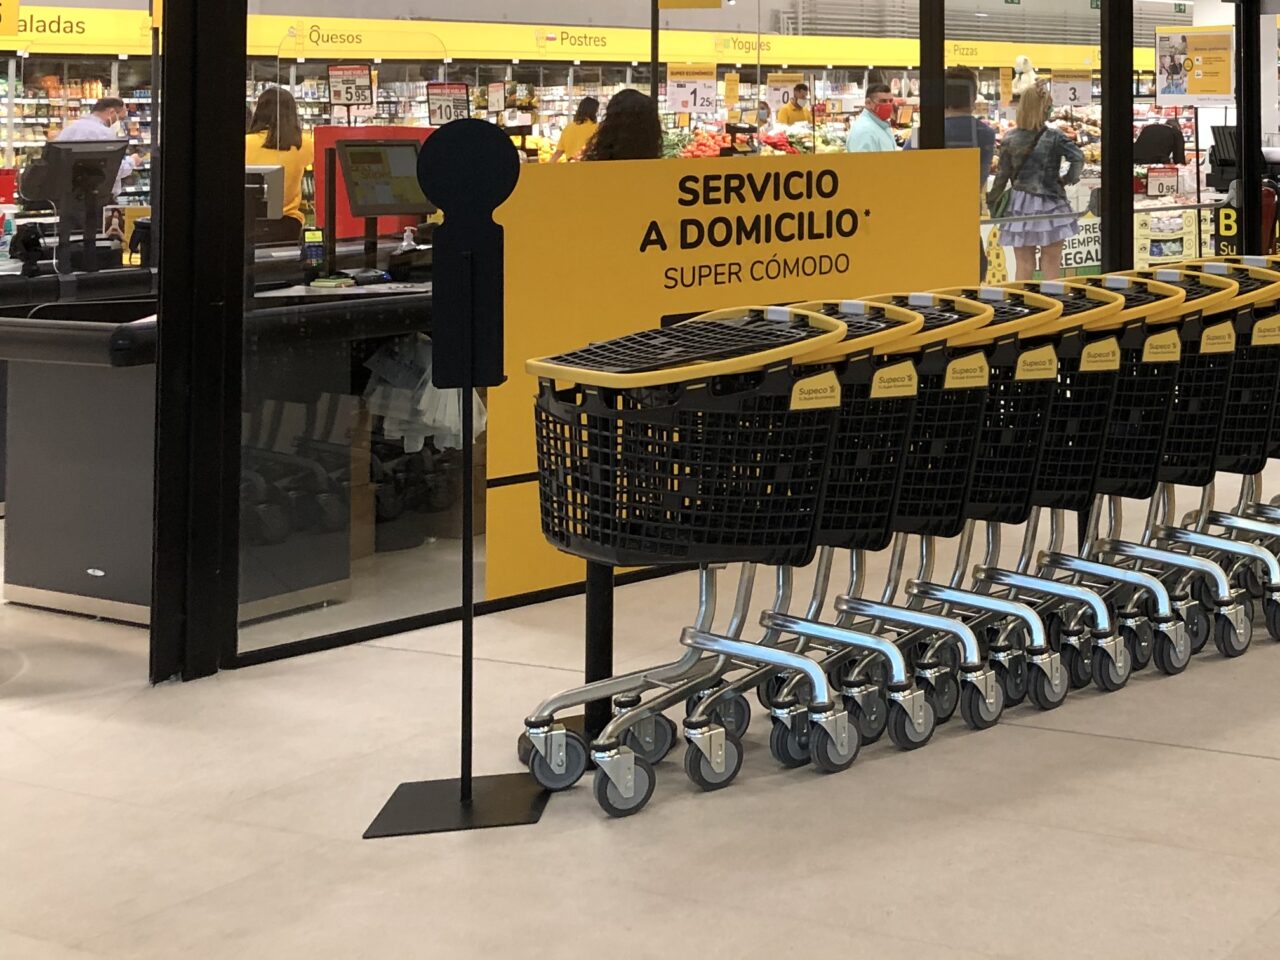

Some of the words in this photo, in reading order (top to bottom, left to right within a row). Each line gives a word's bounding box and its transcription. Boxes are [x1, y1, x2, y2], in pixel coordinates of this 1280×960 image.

[308, 29, 363, 46] Quesos
[559, 30, 607, 47] Postres
[730, 37, 772, 54] Yogues
[953, 44, 978, 57] Pizzas
[677, 169, 839, 207] SERVICIO
[639, 220, 668, 253] A
[1060, 248, 1102, 267] EGAL
[663, 262, 743, 290] SUPER
[749, 253, 850, 281] CÓMODO
[879, 375, 906, 385] Supeco
[798, 387, 828, 396] Supeco
